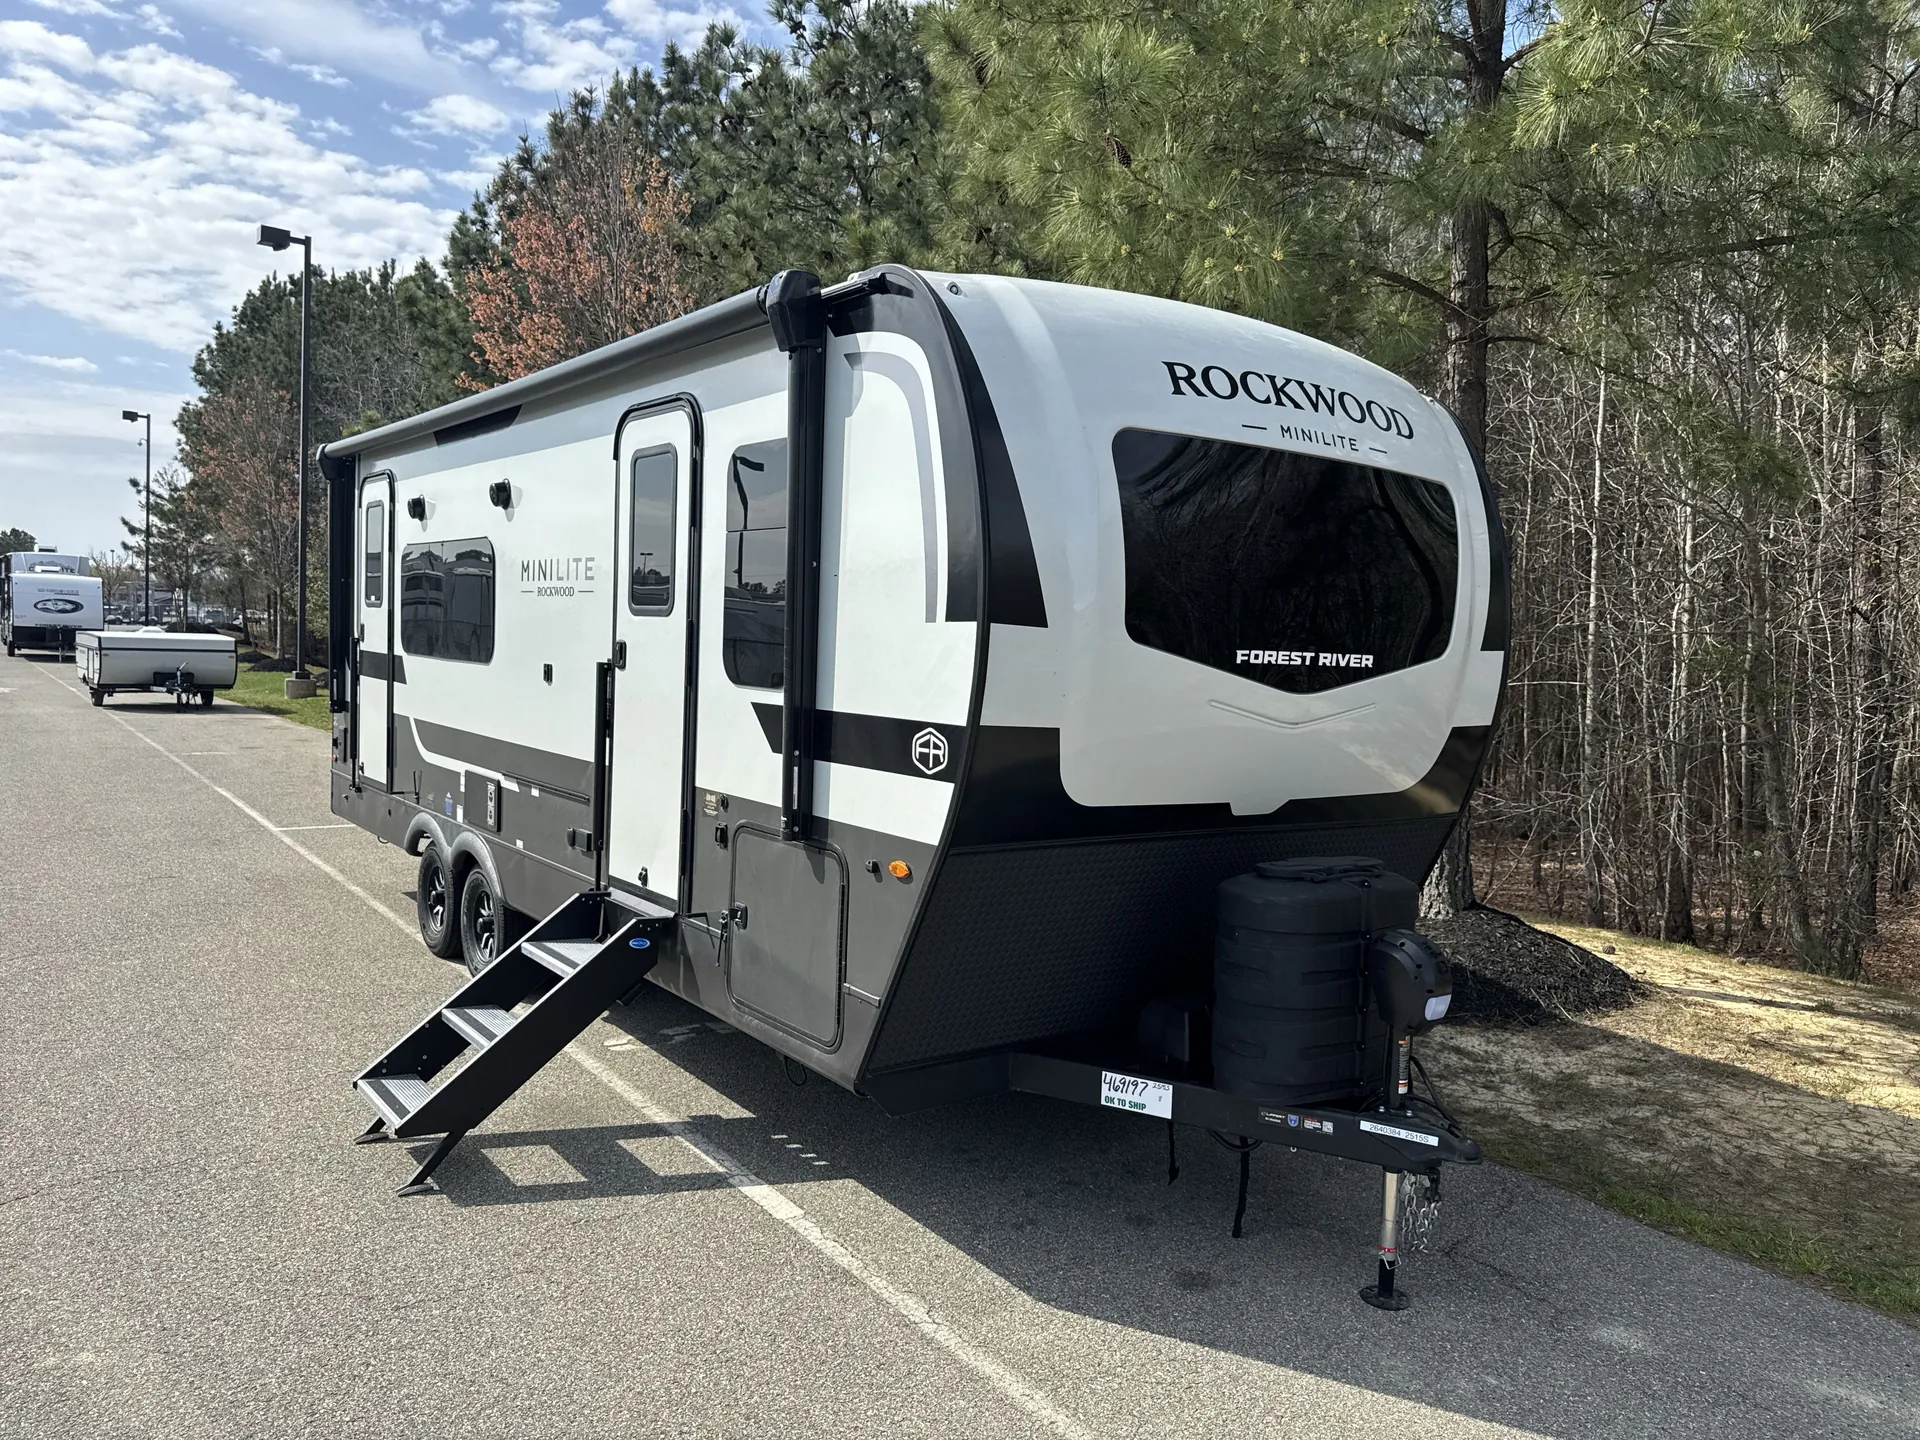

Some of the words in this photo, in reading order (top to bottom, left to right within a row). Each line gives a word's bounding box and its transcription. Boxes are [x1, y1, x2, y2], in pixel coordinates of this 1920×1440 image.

[1161, 360, 1414, 440] ROCKWOOD
[1280, 424, 1359, 451] MINILITE
[521, 557, 595, 581] MINILITE
[537, 586, 575, 597] ROCKWOOD
[1236, 650, 1315, 665] FOREST
[1318, 652, 1374, 668] RIVER
[1103, 1073, 1149, 1097] 469197
[1104, 1095, 1116, 1105] OK
[1117, 1098, 1127, 1107] TO
[1128, 1100, 1147, 1111] SHIP
[1369, 1123, 1401, 1136] 2640384
[1405, 1131, 1429, 1143] 2515S
